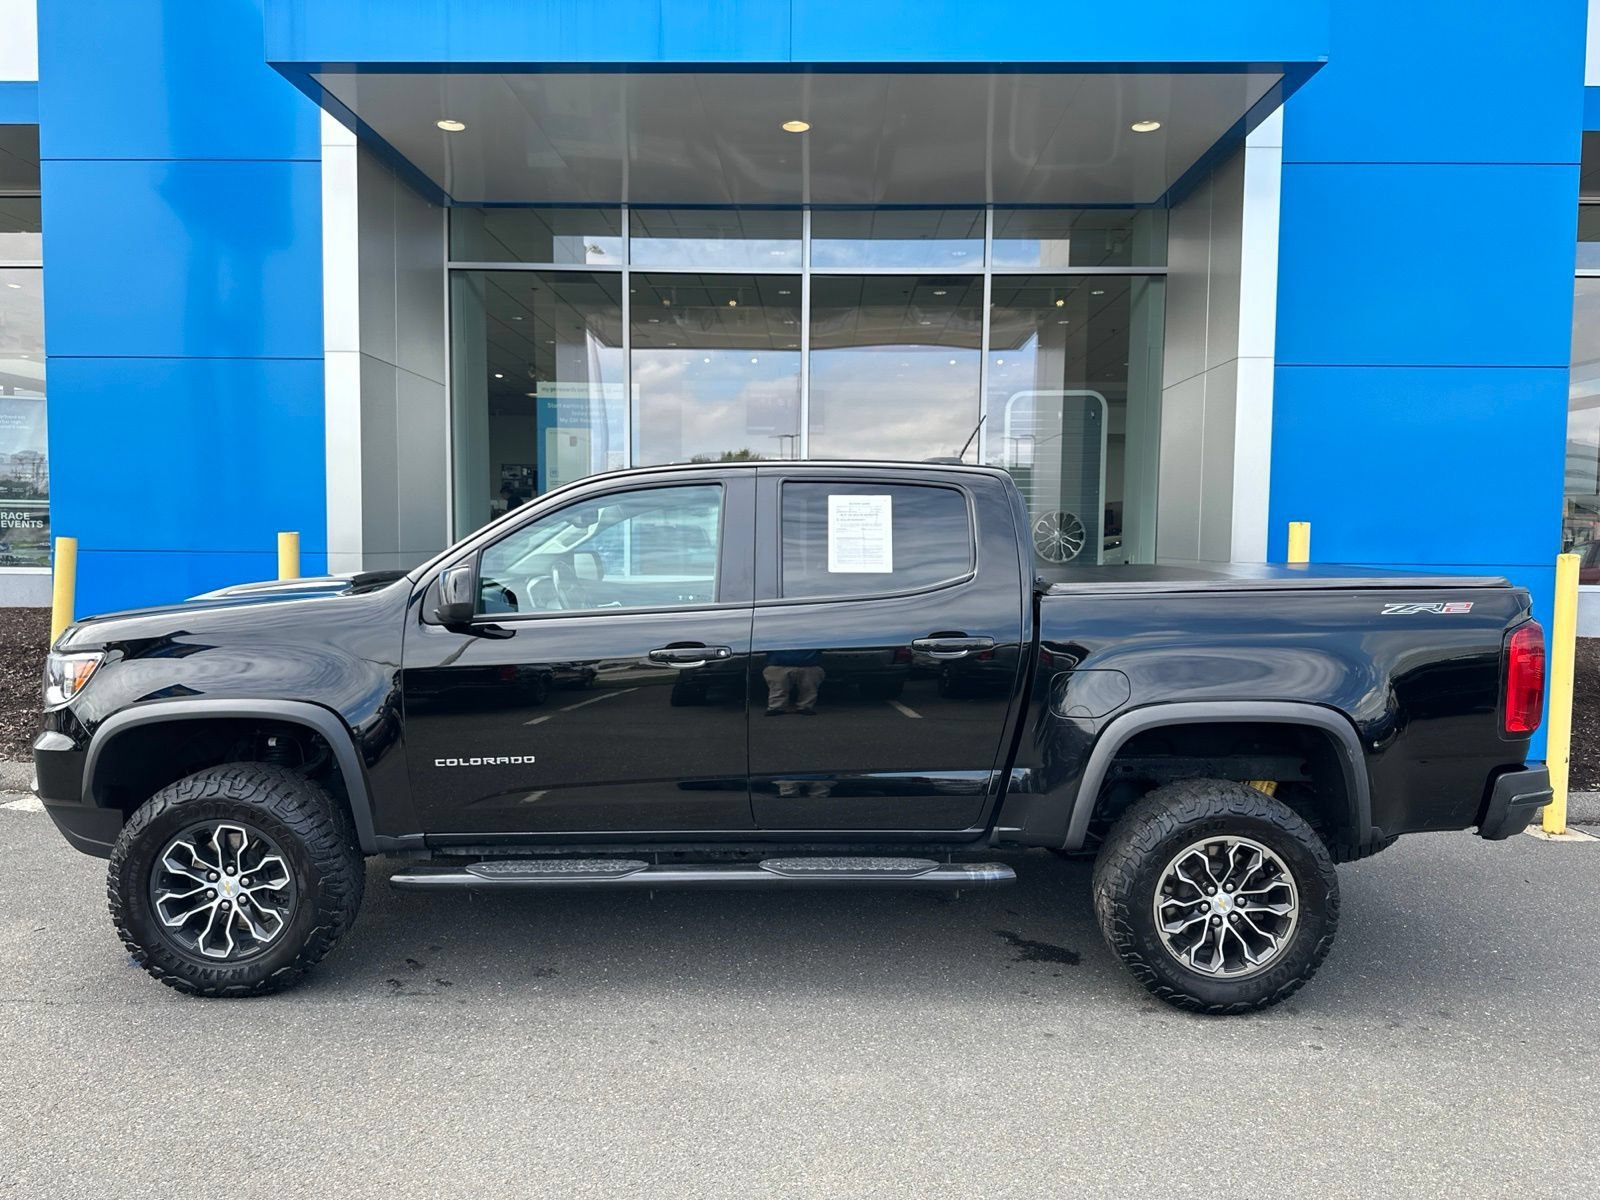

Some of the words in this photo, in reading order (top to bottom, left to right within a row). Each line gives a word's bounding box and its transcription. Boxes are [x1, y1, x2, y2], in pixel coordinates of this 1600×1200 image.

[0, 511, 31, 520] RACE
[0, 520, 44, 528] EVENTS
[1380, 601, 1474, 615] ZR2
[434, 755, 536, 767] COLORADO
